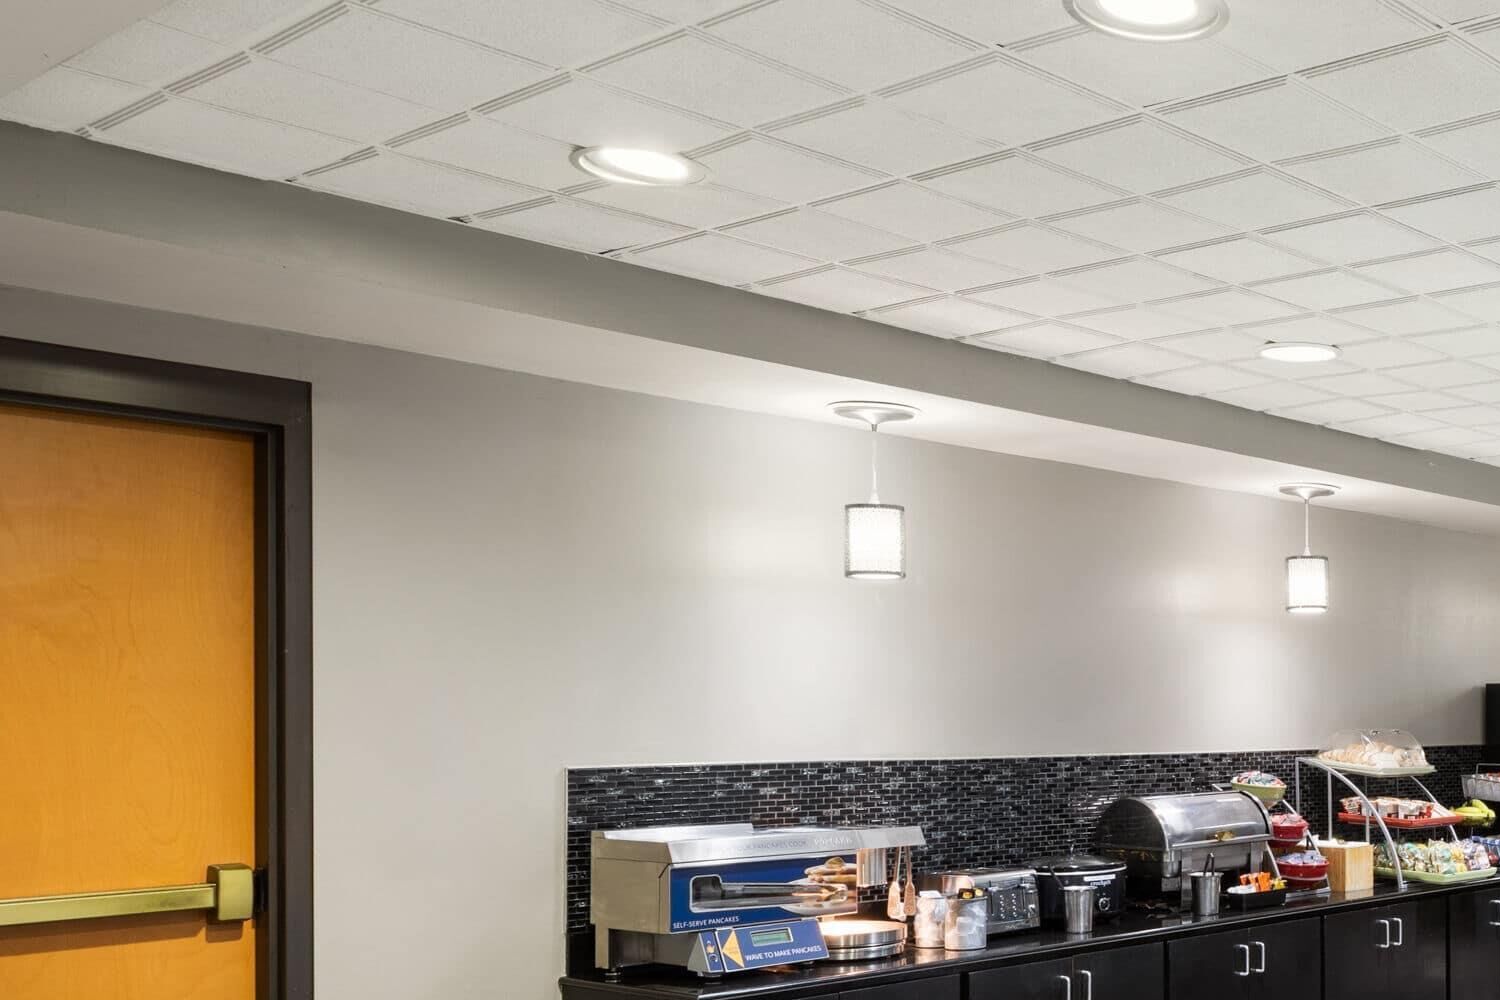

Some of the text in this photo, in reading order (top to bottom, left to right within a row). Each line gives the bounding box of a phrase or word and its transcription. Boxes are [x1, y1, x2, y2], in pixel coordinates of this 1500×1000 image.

[673, 915, 740, 929] SELF-SERVE PANCAKES
[745, 953, 763, 961] WAVE
[774, 949, 791, 957] MAKE
[792, 945, 822, 955] PANCAKES
